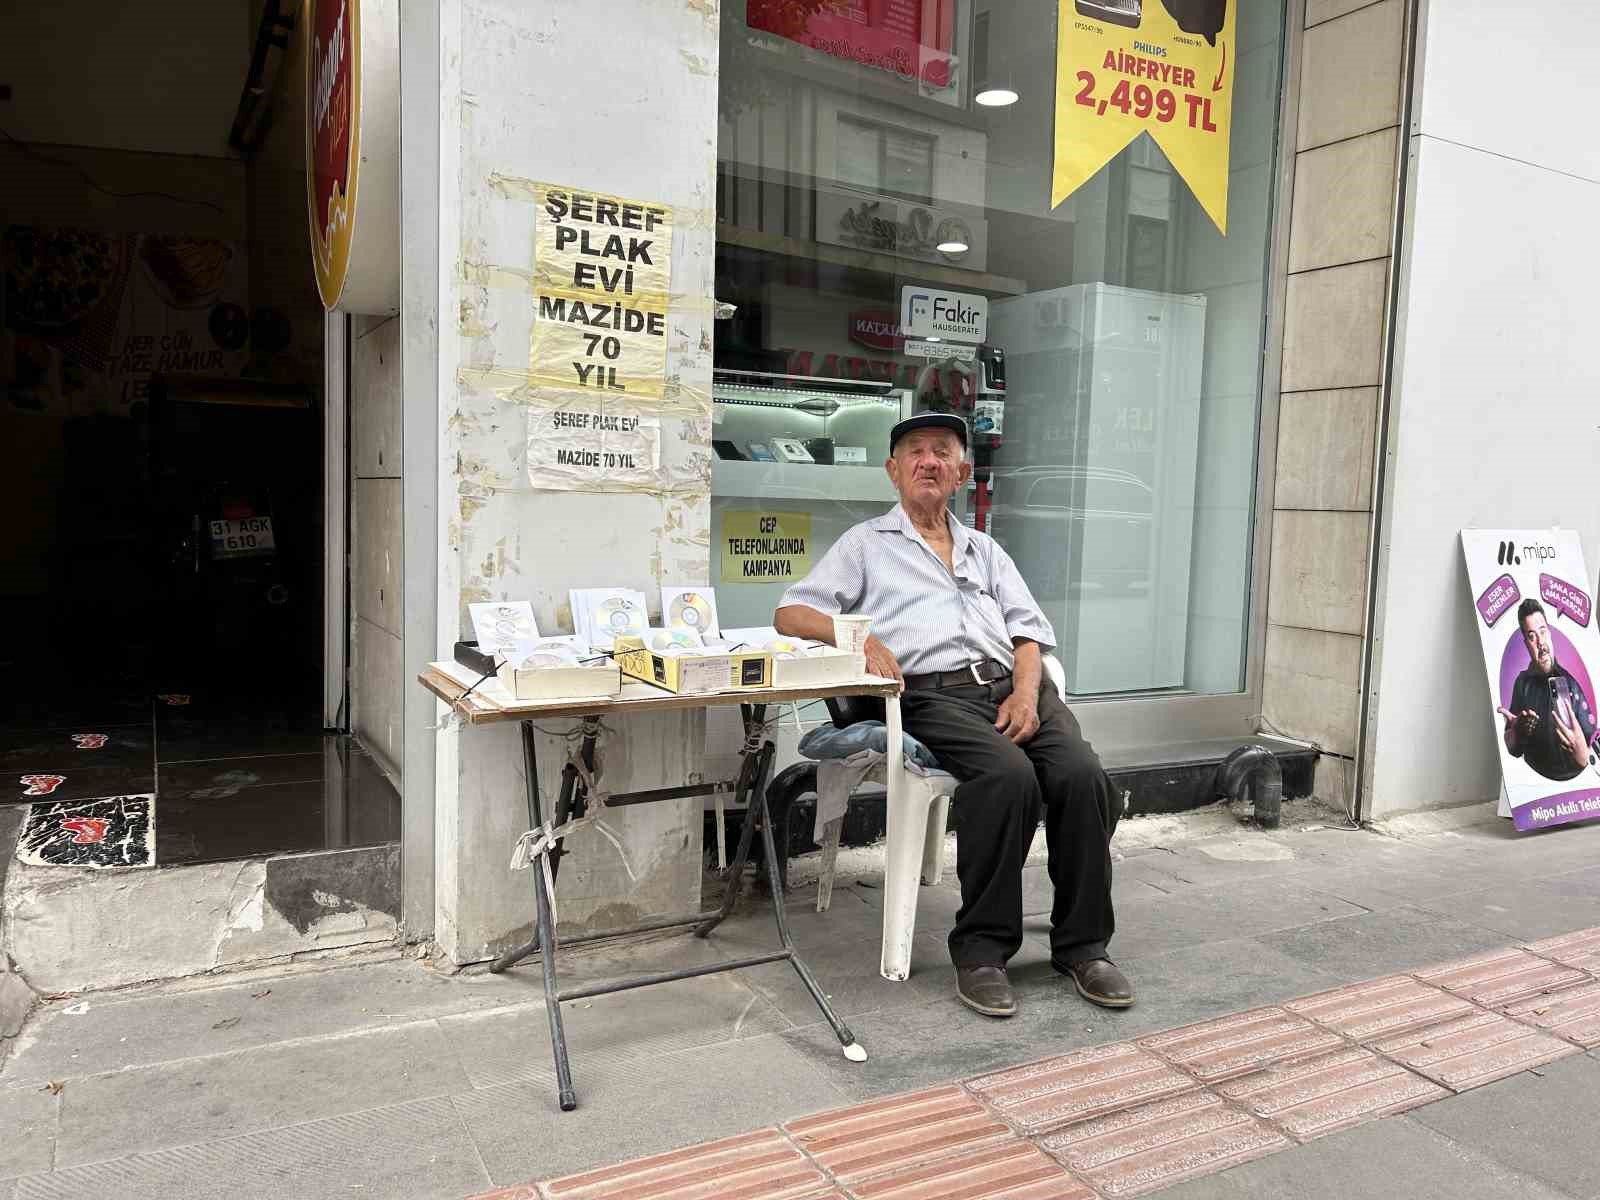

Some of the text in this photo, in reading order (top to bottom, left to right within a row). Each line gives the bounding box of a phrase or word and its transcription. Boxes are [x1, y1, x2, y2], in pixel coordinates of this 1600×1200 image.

[1133, 40, 1167, 57] PHILIPS
[1102, 48, 1195, 88] AİRFRYER
[1075, 70, 1217, 133] 2,499 TL
[545, 190, 665, 232] ŞEREF
[555, 225, 653, 265] PLAK
[573, 262, 634, 295] EVİ
[538, 296, 665, 336] MAZİDE
[932, 297, 980, 325] Fakir
[583, 332, 621, 360] 70
[573, 361, 626, 391] YIL
[553, 411, 639, 431] ŞEREF PLAK EVİ
[557, 448, 635, 468] MAZİDE 70 YIL
[239, 518, 269, 533] AGK
[759, 517, 777, 534] CEP
[227, 534, 257, 549] 610
[728, 538, 806, 556] TELEFONLARINDA
[1523, 542, 1556, 564] mipo
[743, 559, 792, 577] KAMPANYA
[1531, 806, 1556, 822] Mipo
